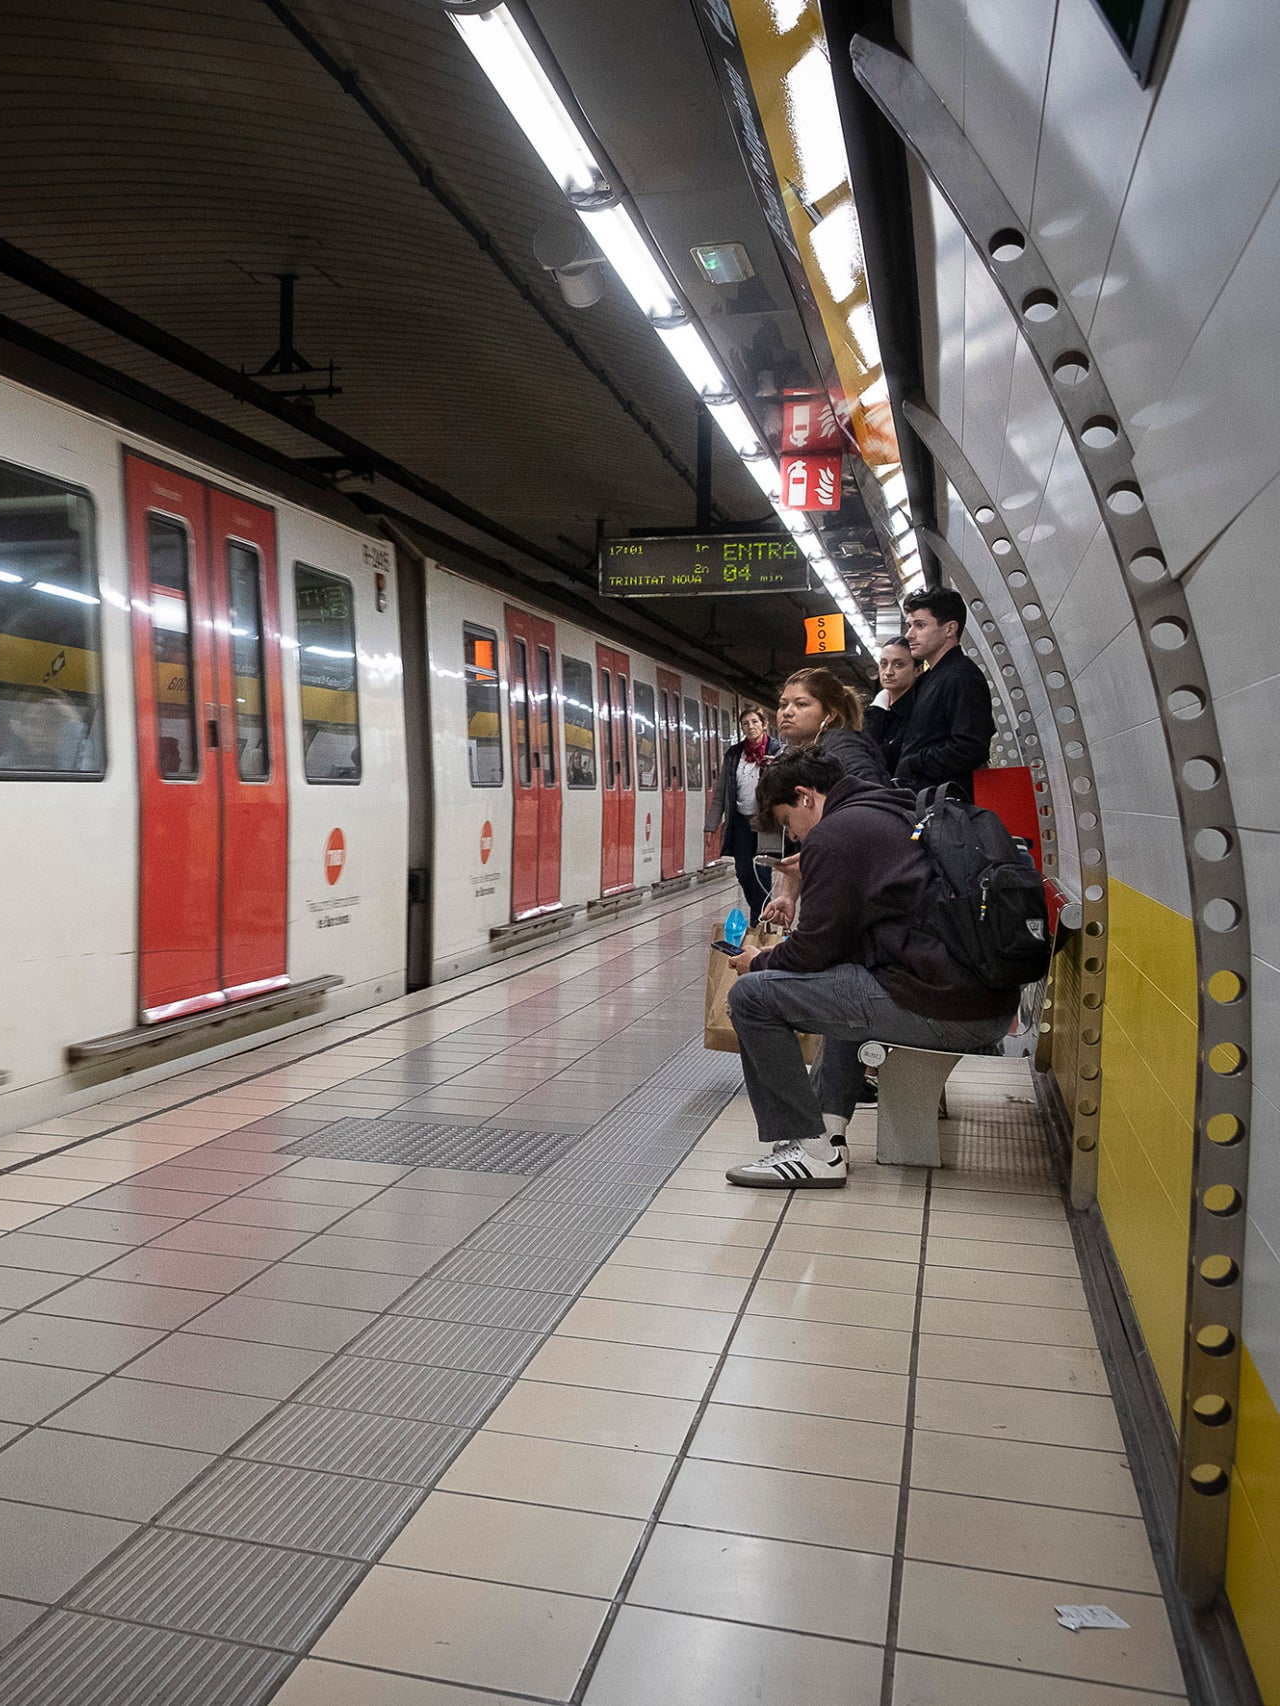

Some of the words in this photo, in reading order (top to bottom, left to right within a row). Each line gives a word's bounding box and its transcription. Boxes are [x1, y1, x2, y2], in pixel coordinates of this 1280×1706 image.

[608, 545, 644, 556] 17:01
[723, 542, 798, 561] ENTRA
[609, 575, 665, 586] TRINITAT
[672, 574, 703, 584] NOVA
[693, 563, 710, 574] 2n
[723, 563, 752, 582] 04
[760, 574, 783, 582] min
[817, 617, 828, 652] SOS
